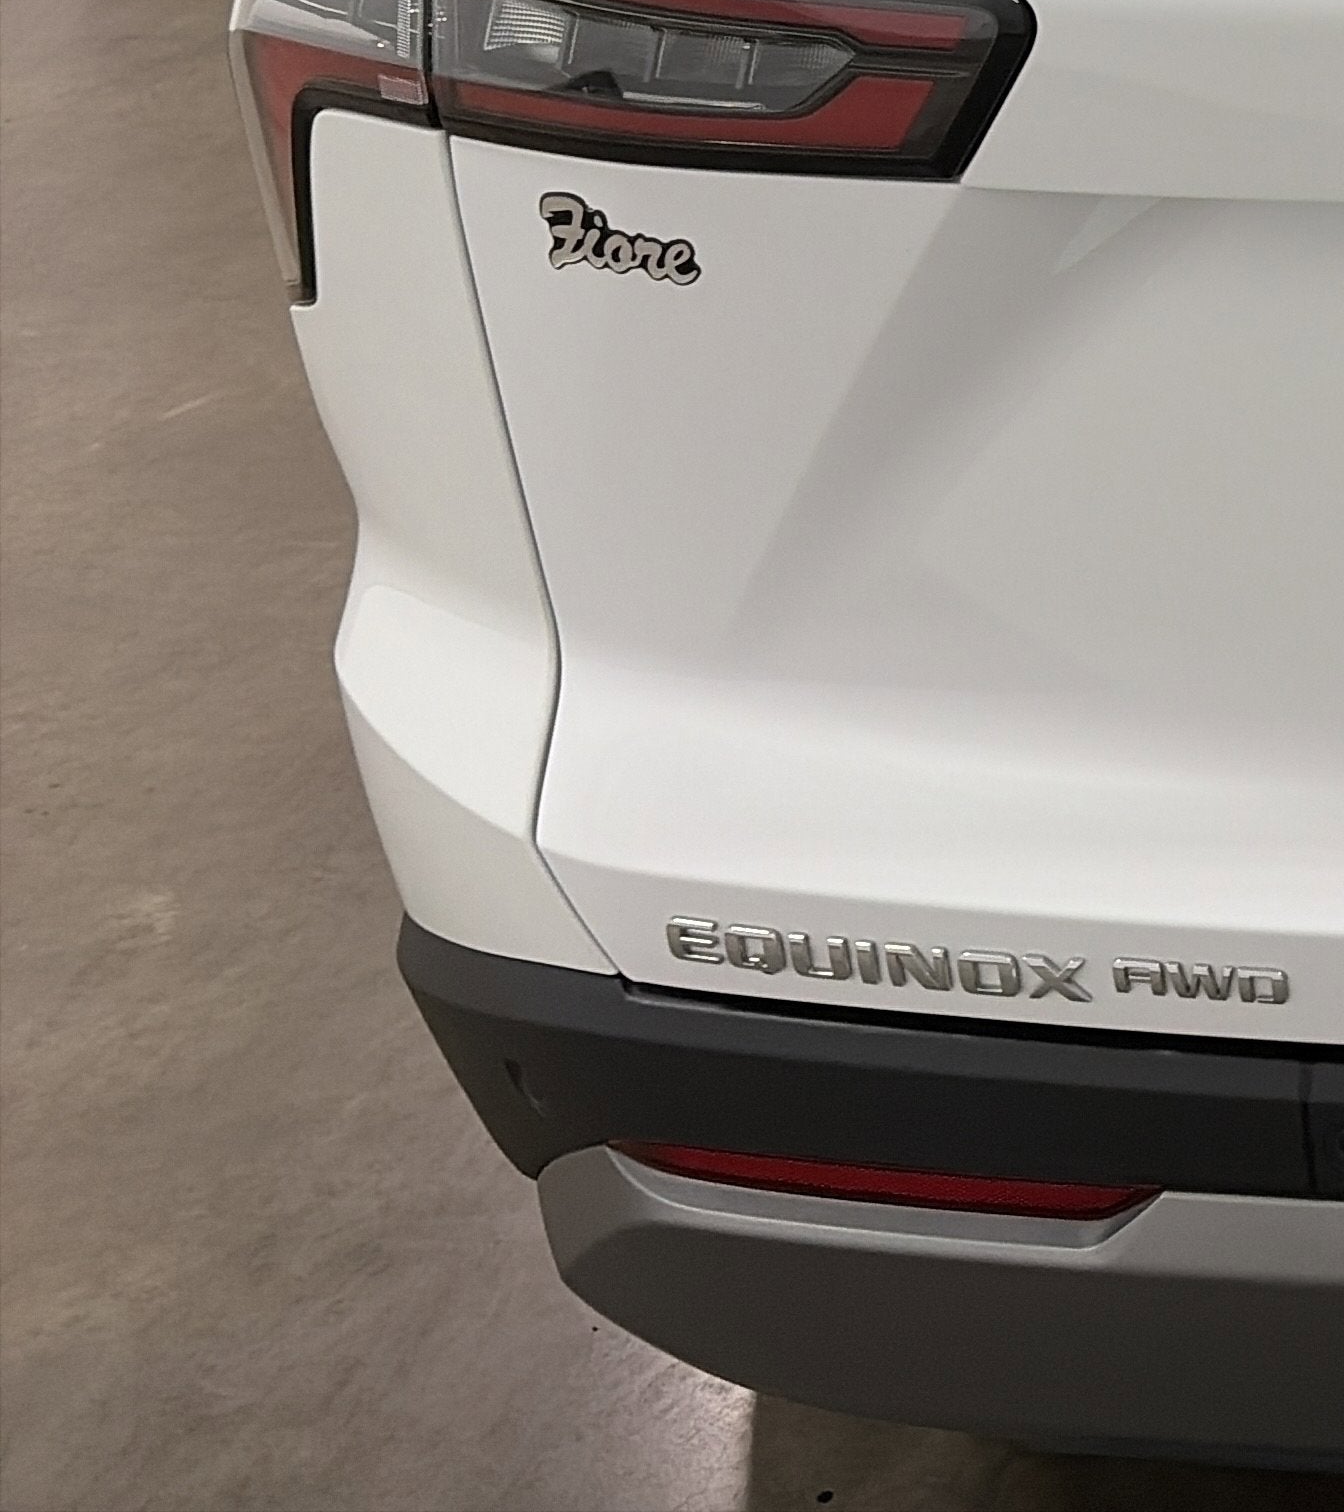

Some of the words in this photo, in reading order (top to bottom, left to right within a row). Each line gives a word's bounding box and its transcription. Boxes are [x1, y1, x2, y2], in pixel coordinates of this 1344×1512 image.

[539, 191, 702, 286] Fiore
[666, 915, 1094, 1003] EQUINOX
[1112, 956, 1290, 1005] AWD
